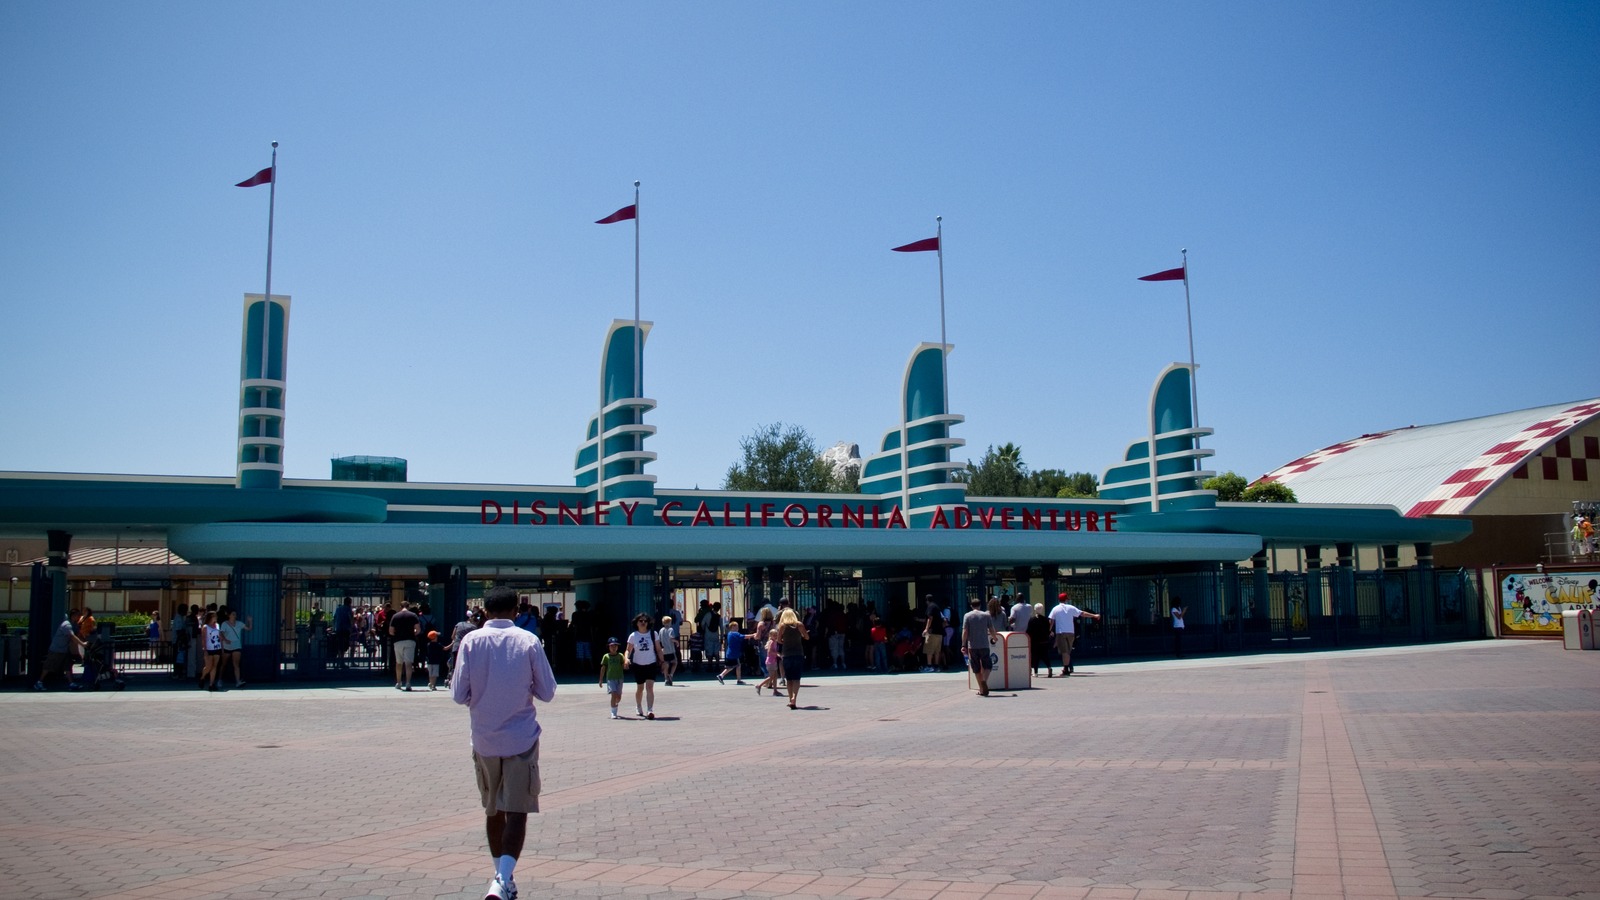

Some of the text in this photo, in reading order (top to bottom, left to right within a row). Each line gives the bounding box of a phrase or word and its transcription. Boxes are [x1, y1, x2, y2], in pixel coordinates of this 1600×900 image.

[481, 500, 1118, 532] DISNEY CALIFORNIA ADVENTURE
[1528, 577, 1553, 585] WELCOME
